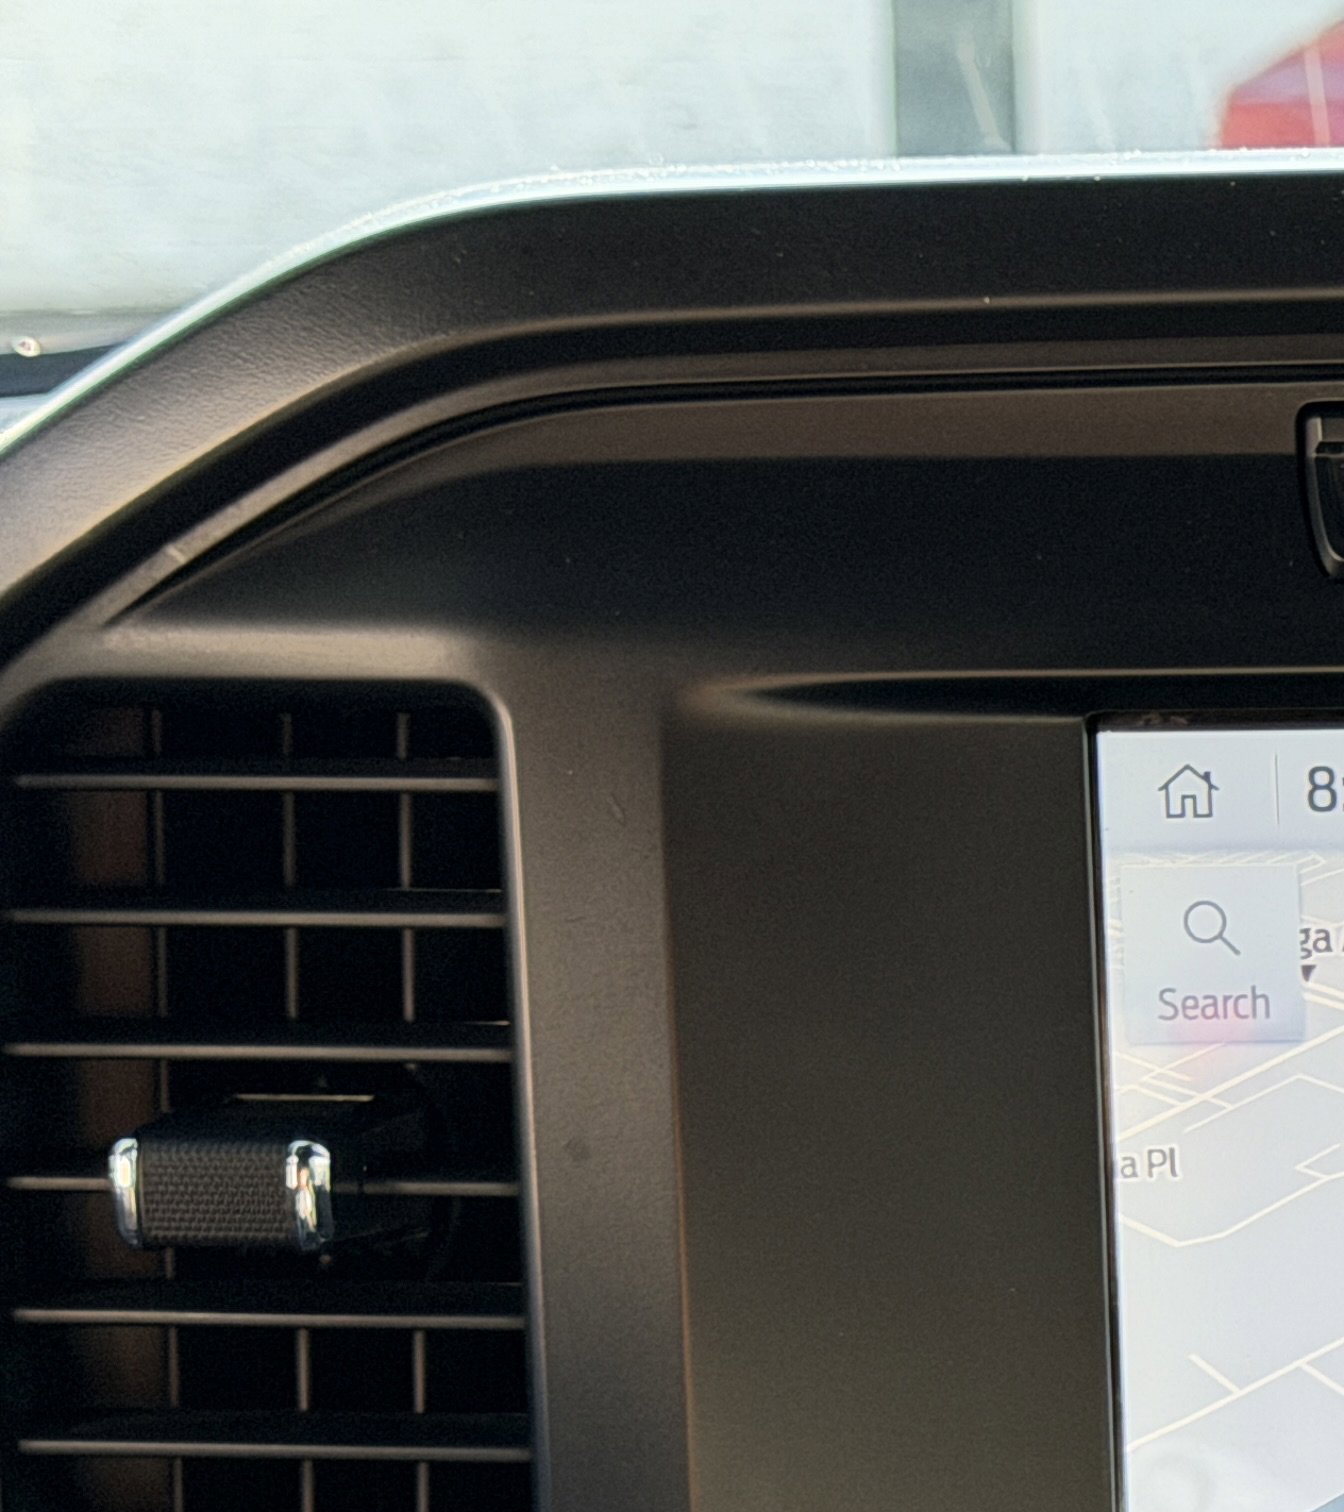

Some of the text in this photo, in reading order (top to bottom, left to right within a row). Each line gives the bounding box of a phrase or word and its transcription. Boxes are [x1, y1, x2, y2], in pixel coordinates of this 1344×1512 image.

[1157, 986, 1270, 1022] Search
[1120, 1147, 1178, 1178] a Pl
